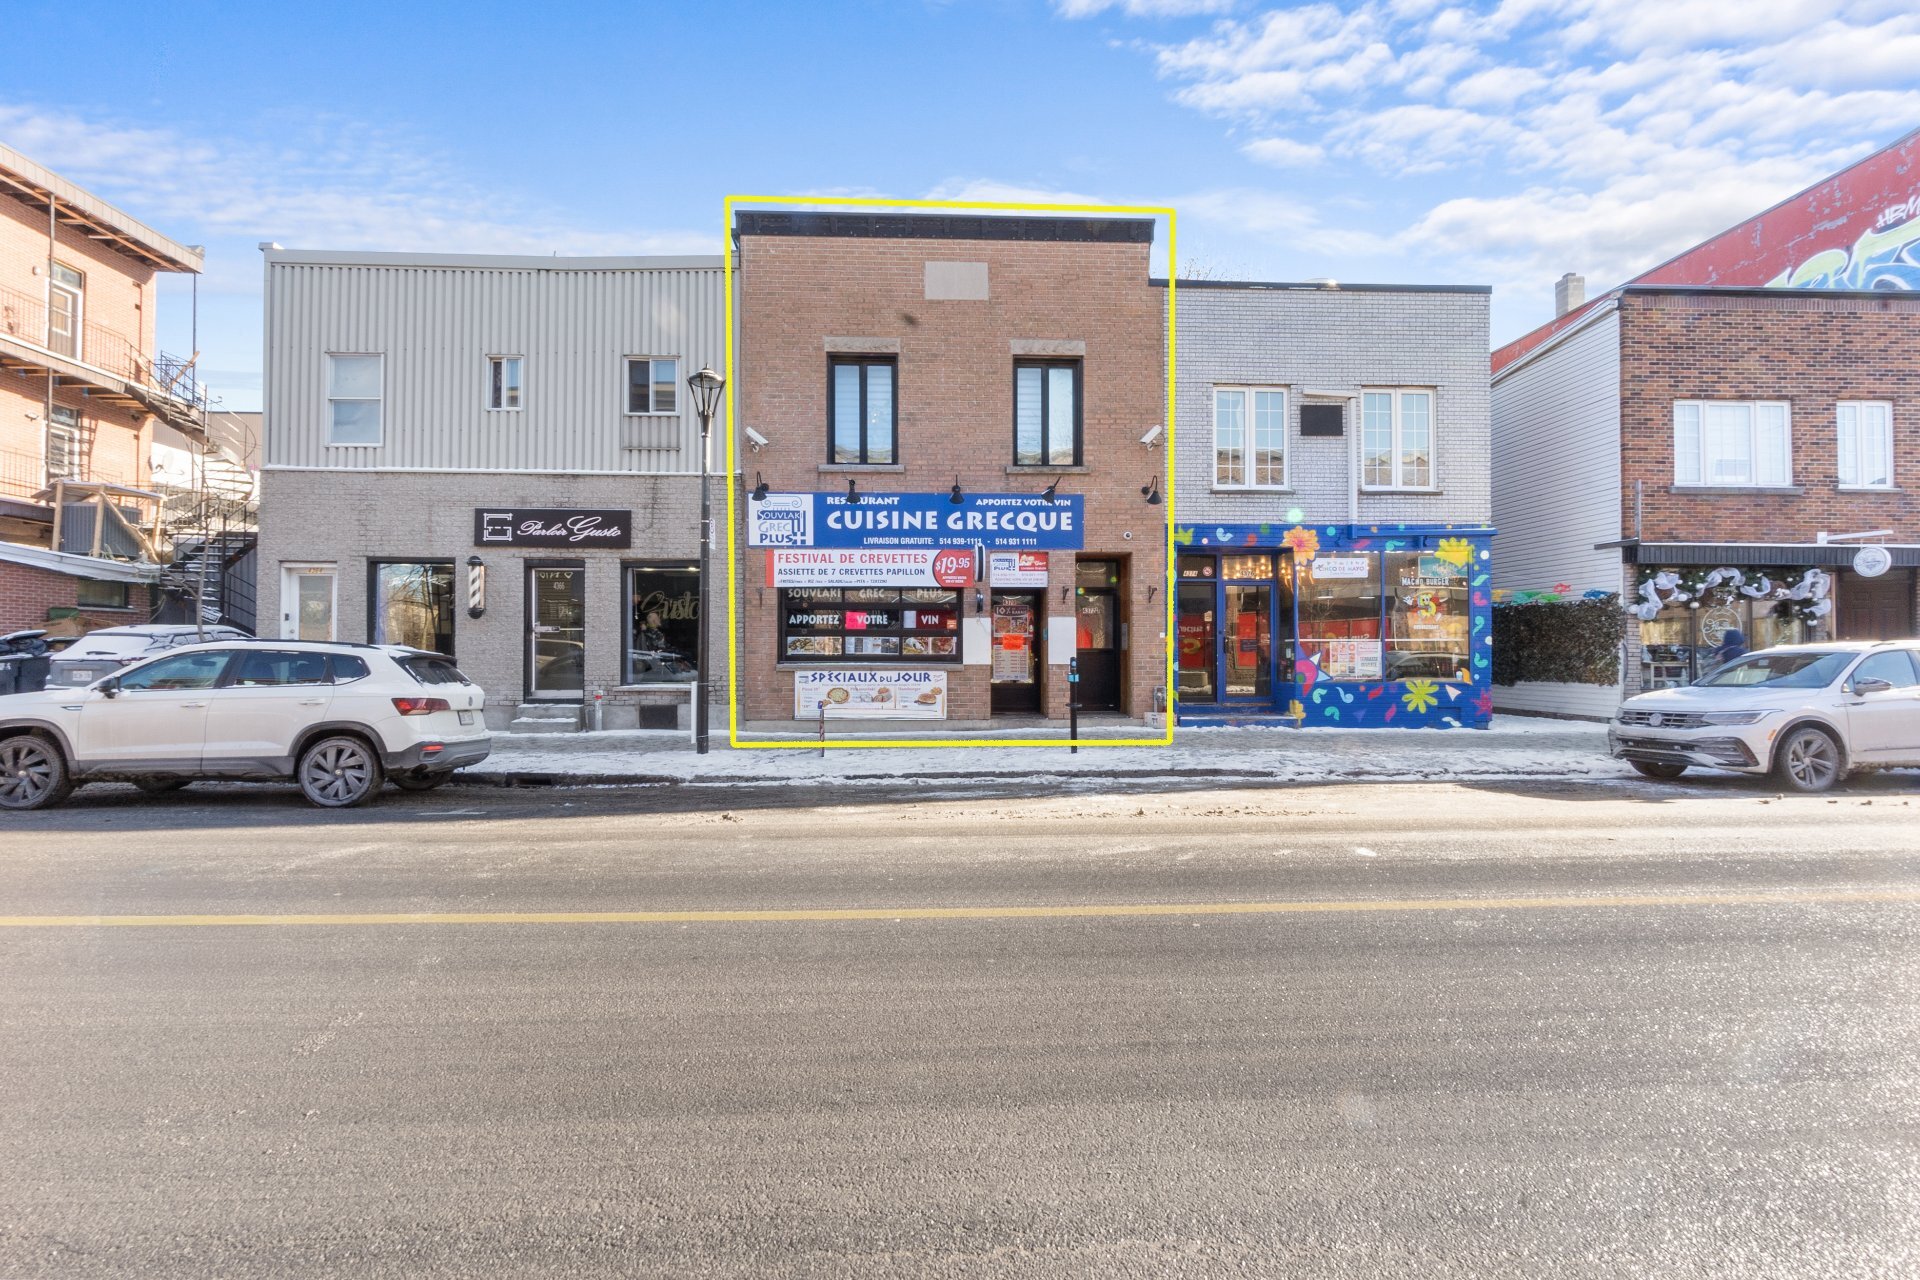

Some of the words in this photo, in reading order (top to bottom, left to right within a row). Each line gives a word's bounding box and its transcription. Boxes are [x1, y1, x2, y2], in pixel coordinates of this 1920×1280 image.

[826, 496, 900, 505] RESURANT
[975, 498, 1022, 506] APPORTEZ
[1054, 499, 1071, 507] VIN
[757, 510, 803, 520] SOUVLAKI
[758, 521, 791, 533] GREC
[826, 510, 938, 530] CUISINE
[946, 511, 1073, 533] GRECQUE
[517, 520, 569, 537] Parloir
[566, 515, 622, 542] Gusto
[759, 533, 794, 544] PLUS
[863, 537, 899, 545] LIVRAISON
[900, 537, 935, 545] GRATUITE:
[939, 537, 952, 545] 514
[952, 537, 982, 545] 939-1111
[995, 537, 1008, 546] 514
[1008, 537, 1020, 546] 931
[1021, 537, 1037, 546] 1111
[777, 553, 835, 564] FESTIVAL
[839, 553, 855, 564] DE
[859, 553, 928, 564] CREVETTES
[935, 556, 970, 574] $19.95
[777, 568, 816, 576] ASSIETTE
[818, 568, 828, 576] DE
[831, 568, 836, 576] 7
[838, 568, 884, 576] CREVETTES
[886, 568, 925, 576] PAPILLON
[1426, 577, 1450, 586] BURGER
[788, 588, 841, 598] SOUVLAKI
[858, 588, 885, 598] GREC
[916, 588, 943, 598] PLUS
[788, 614, 840, 625] APPORTEZ
[856, 614, 888, 625] VOTRE
[920, 614, 939, 625] VIN
[810, 670, 878, 683] SPÉCIAUX
[879, 675, 892, 683] DU
[894, 672, 932, 682] JOUR
